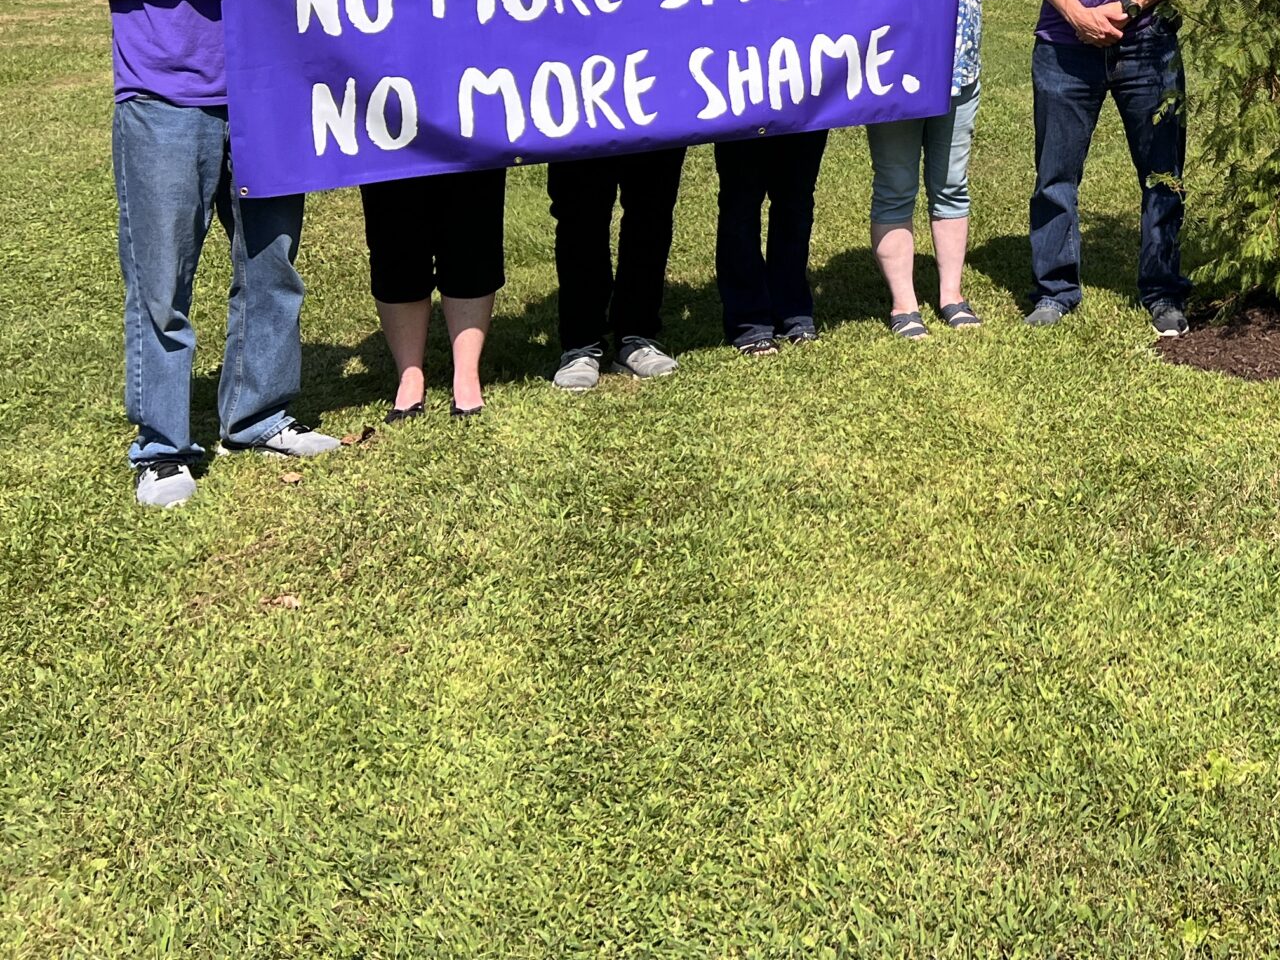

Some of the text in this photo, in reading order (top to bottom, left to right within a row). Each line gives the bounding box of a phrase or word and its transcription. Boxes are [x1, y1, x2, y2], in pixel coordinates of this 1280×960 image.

[311, 25, 920, 156] NO MORE SHAME.
